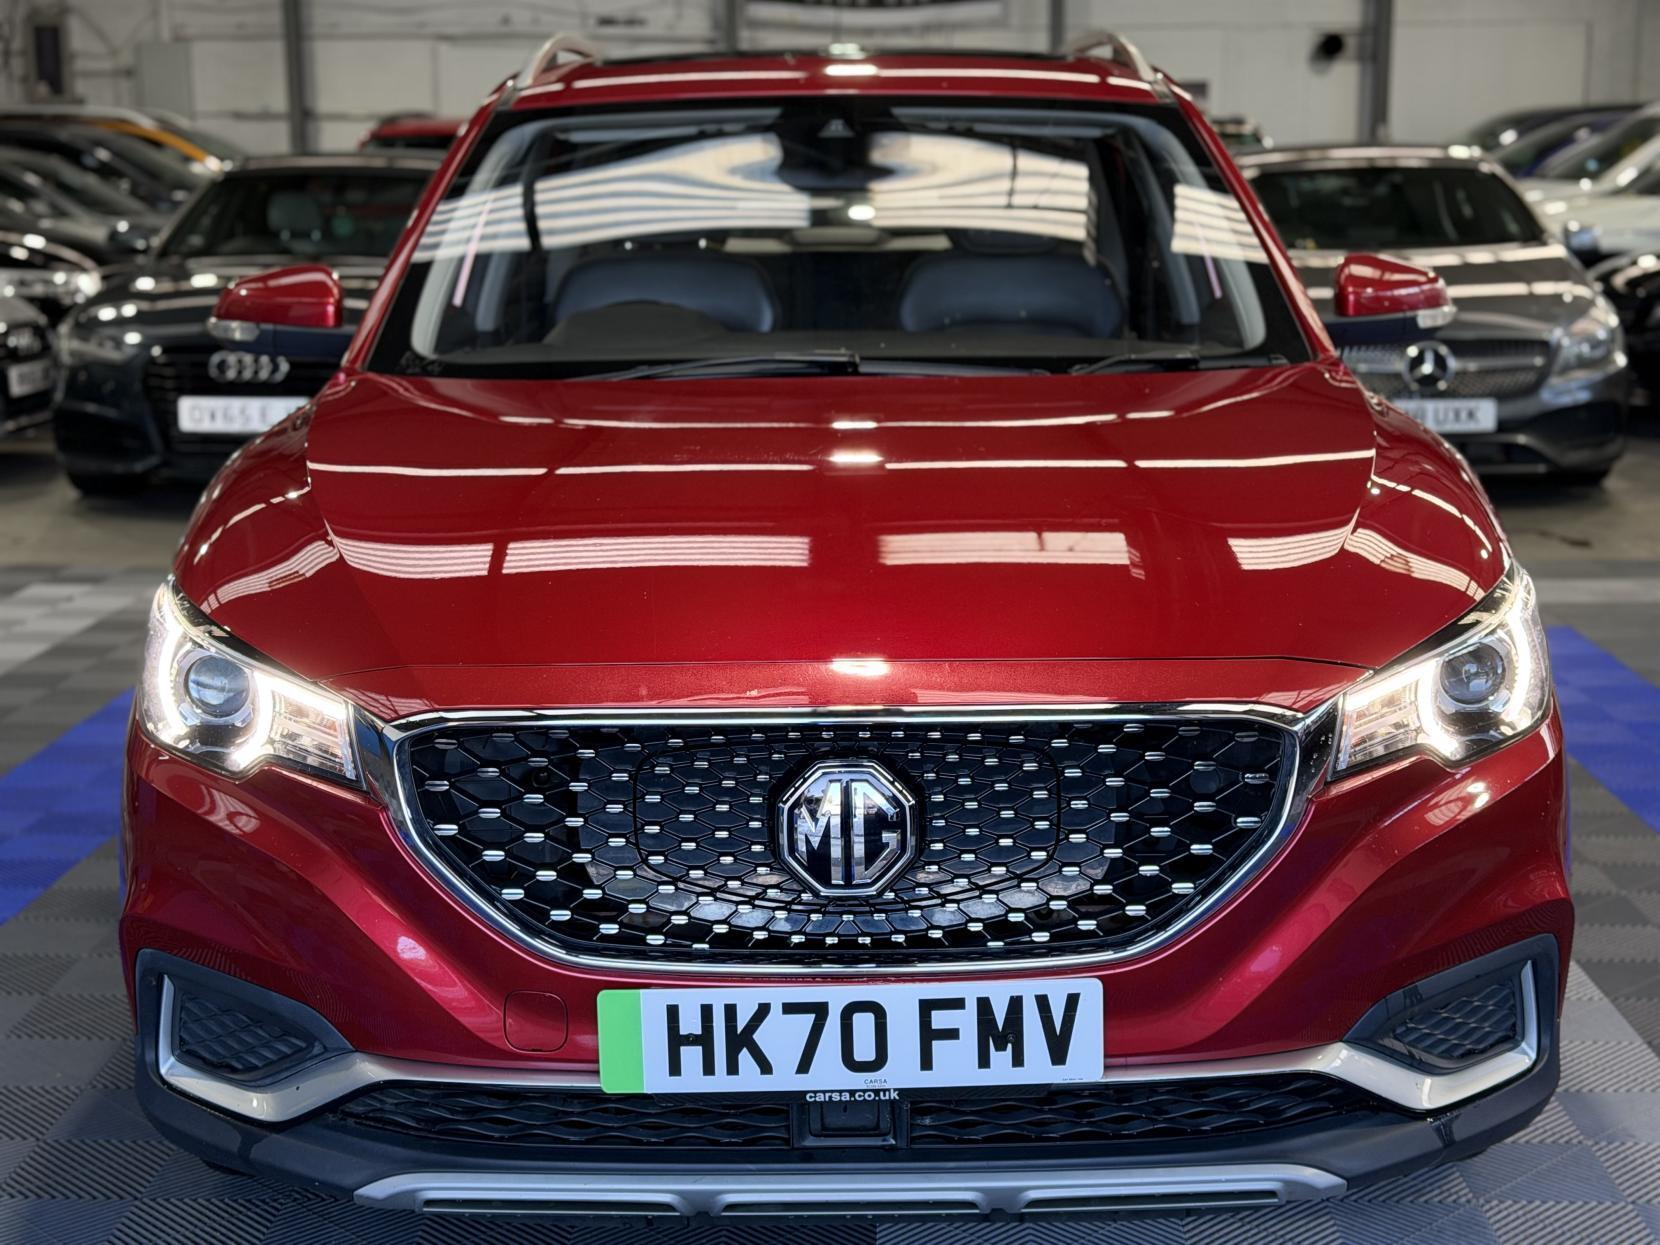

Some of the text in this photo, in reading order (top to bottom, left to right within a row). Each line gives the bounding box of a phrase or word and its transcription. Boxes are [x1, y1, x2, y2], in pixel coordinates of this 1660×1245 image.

[1433, 406, 1481, 425] UXK
[794, 778, 901, 885] MG
[666, 992, 1081, 1077] HK70 FMV
[805, 1089, 900, 1102] carsa.co.uk
